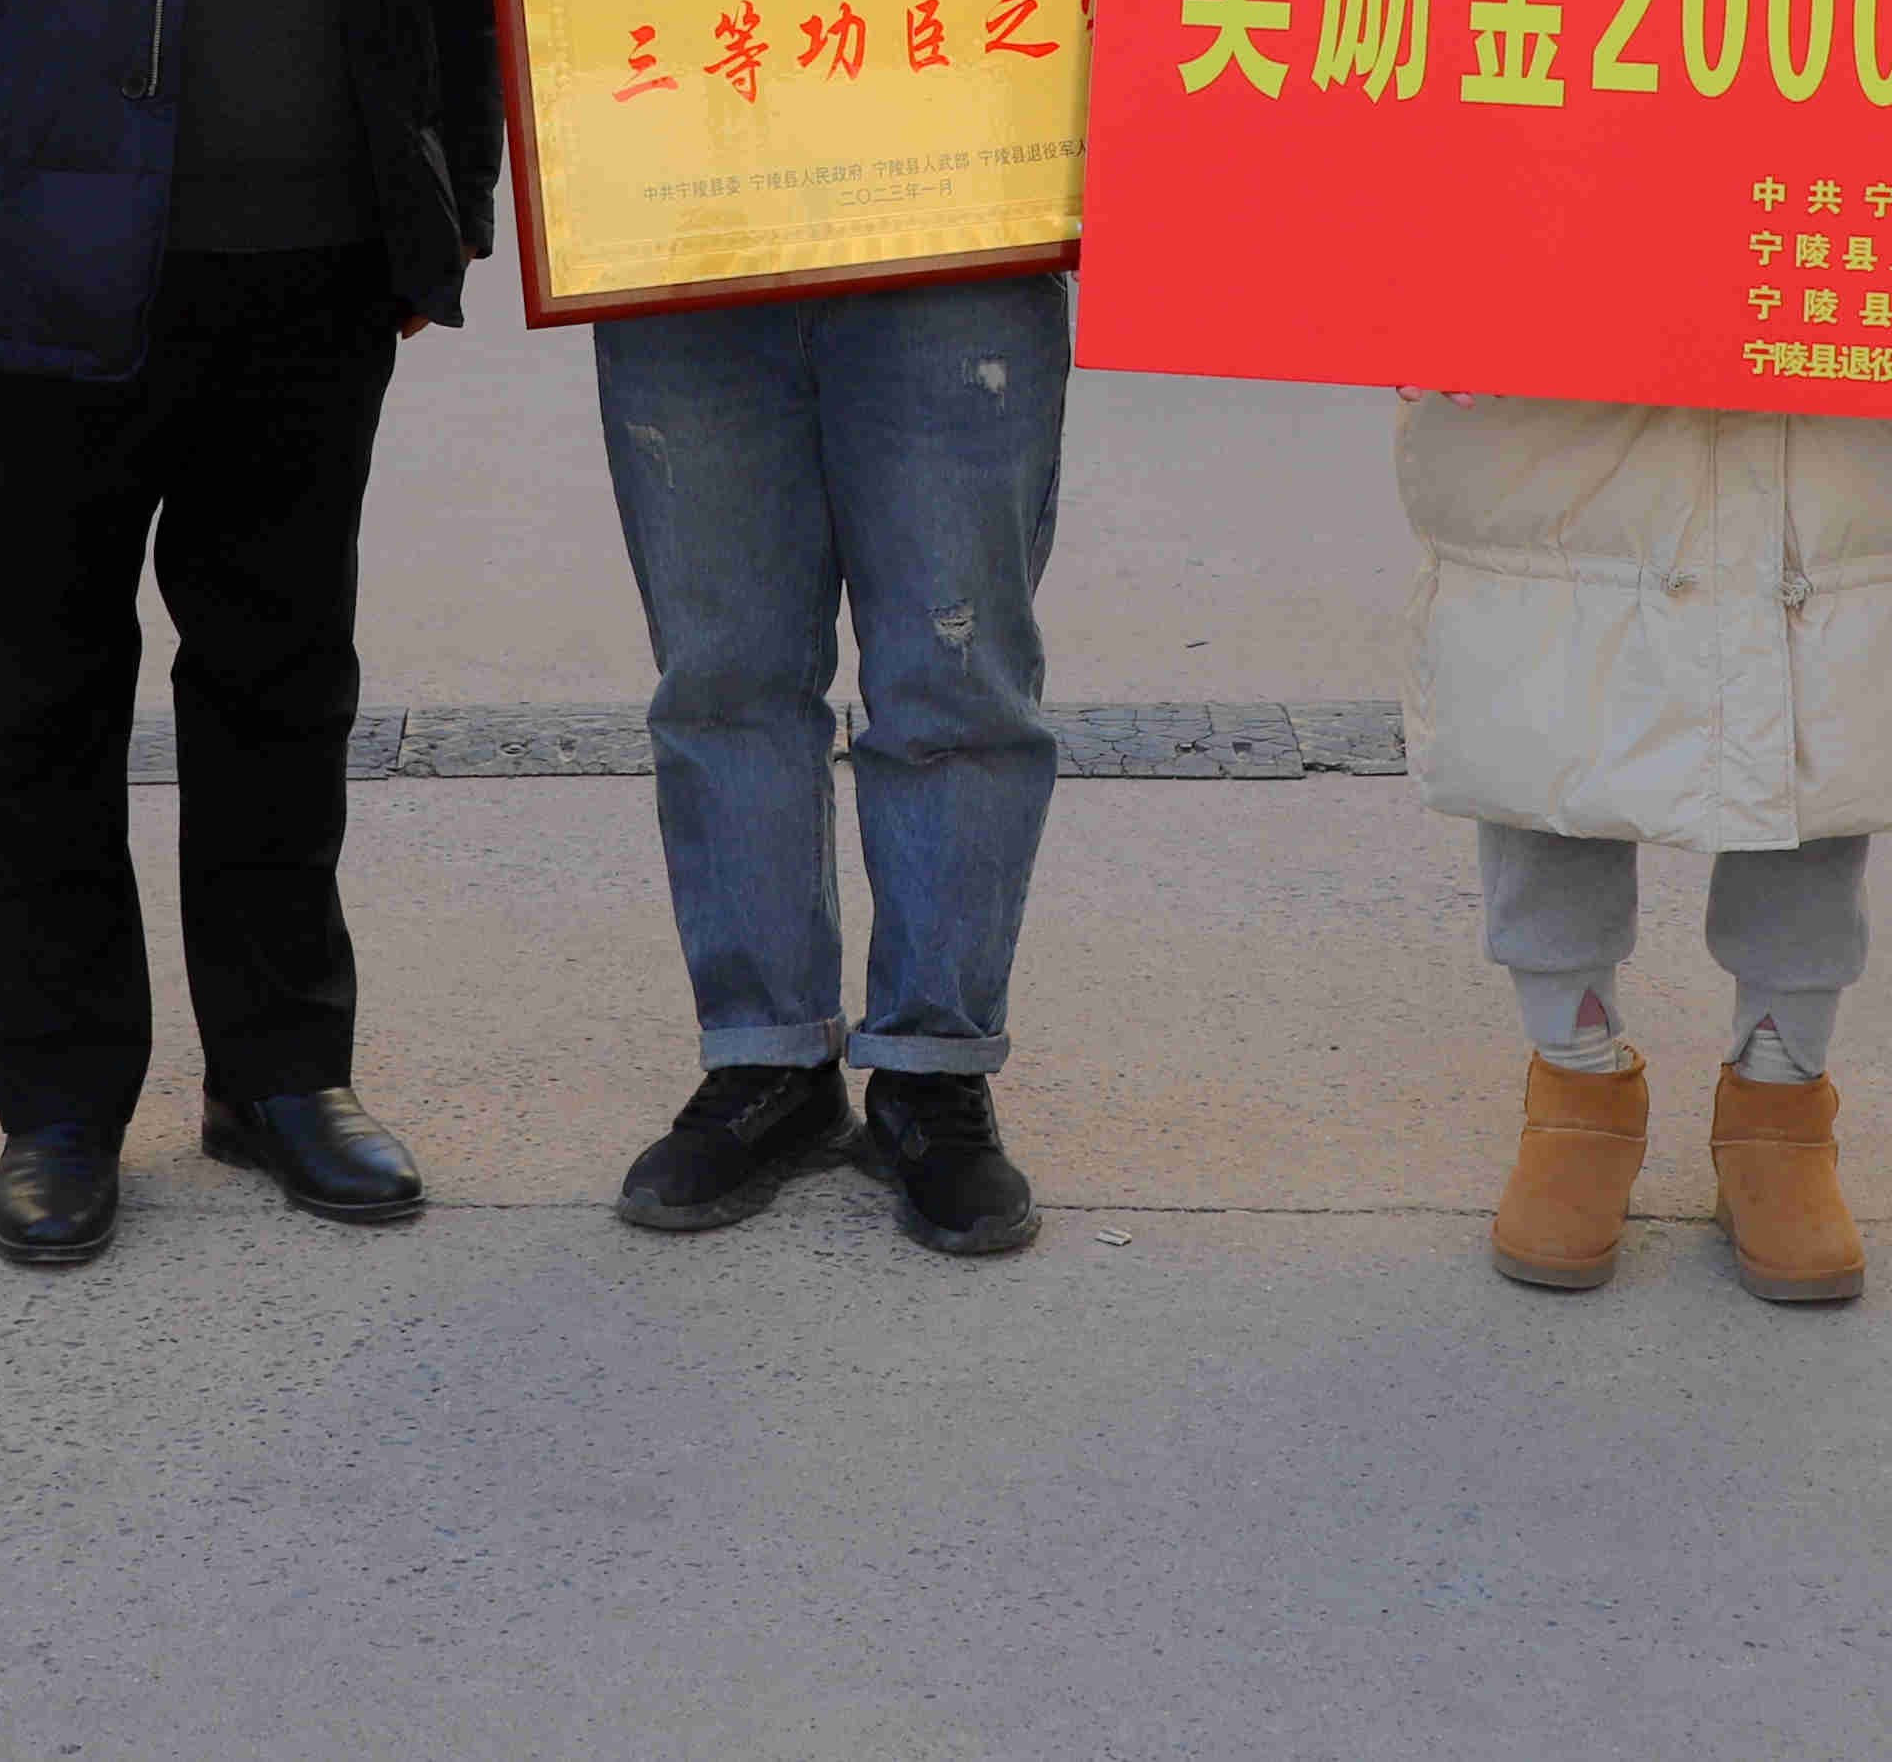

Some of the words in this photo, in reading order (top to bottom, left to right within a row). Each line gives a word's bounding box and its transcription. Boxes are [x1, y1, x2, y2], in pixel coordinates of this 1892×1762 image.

[643, 175, 742, 202] 中共宁陵县委
[749, 160, 864, 192] 宁陵县人民政府
[872, 150, 971, 180] 宁陵县人武部
